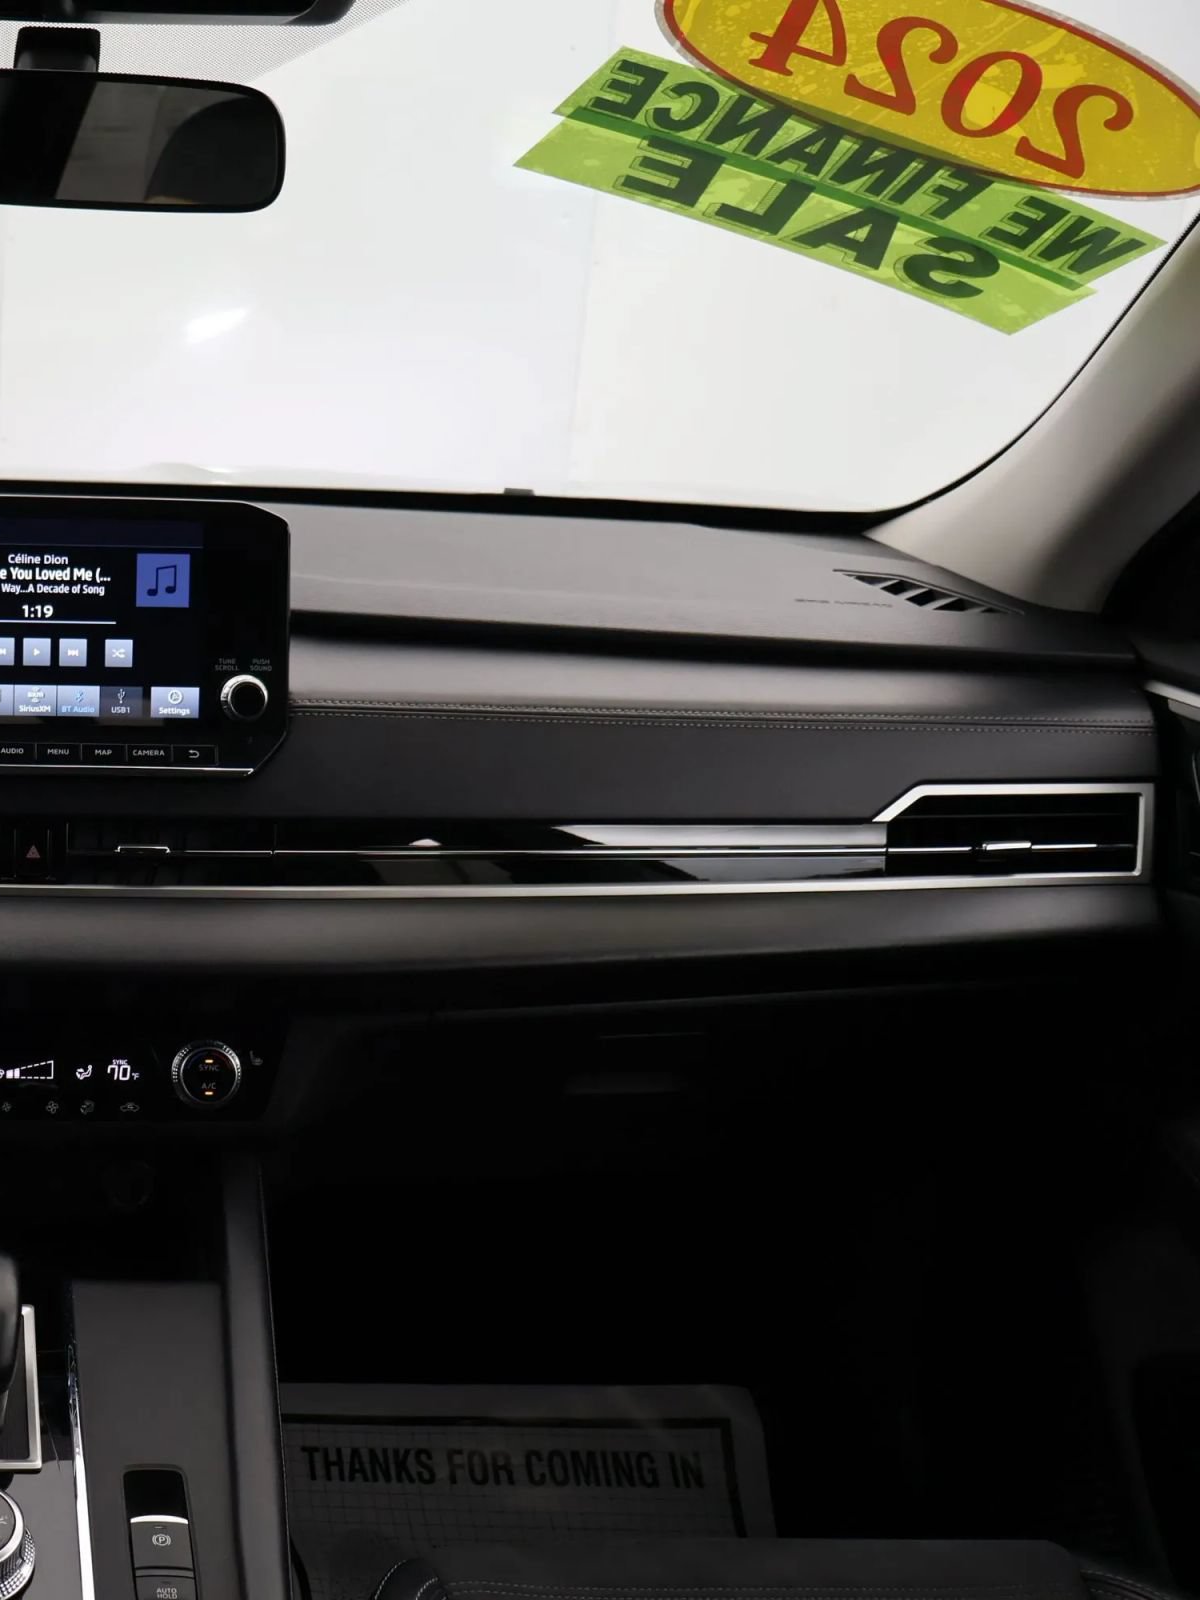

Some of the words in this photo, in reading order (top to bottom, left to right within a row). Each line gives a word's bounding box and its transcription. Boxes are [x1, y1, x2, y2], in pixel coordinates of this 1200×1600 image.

[7, 553, 41, 564] Céline
[43, 554, 69, 565] Dion
[10, 567, 32, 580] You
[35, 567, 70, 581] Loved
[73, 568, 92, 581] Me
[36, 583, 70, 594] Decade
[71, 584, 81, 594] of
[82, 584, 105, 596] Song
[22, 605, 54, 618] 1:19
[19, 705, 51, 713] SiriusXM
[159, 707, 191, 716] Settings
[132, 749, 165, 757] CAMERA
[199, 1064, 220, 1072] SYNC
[201, 1082, 217, 1090] A/C
[302, 1446, 436, 1485] THANKS
[447, 1449, 515, 1486] FOR
[525, 1450, 660, 1488] COMING
[668, 1452, 705, 1488] IN
